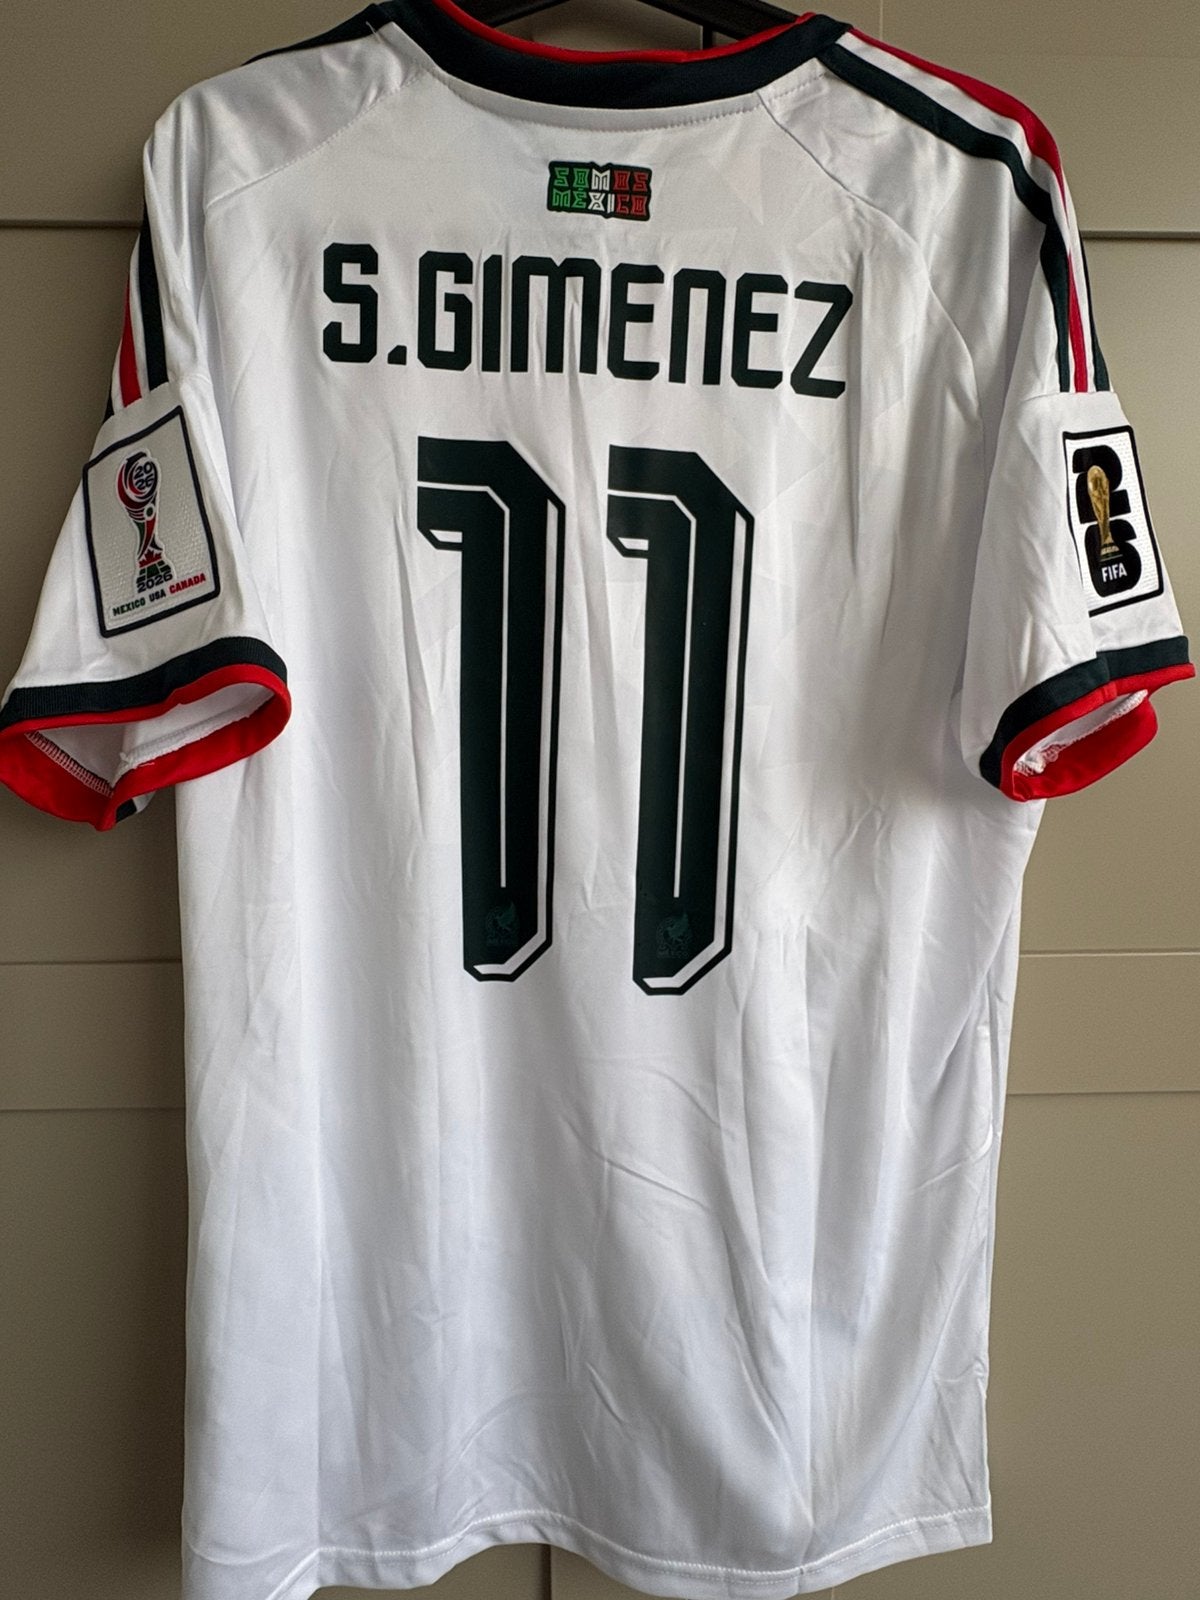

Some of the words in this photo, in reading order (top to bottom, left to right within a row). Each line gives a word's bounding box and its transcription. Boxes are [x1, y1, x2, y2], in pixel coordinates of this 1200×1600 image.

[553, 167, 649, 191] SOMOS
[323, 242, 853, 399] S.GIMENEZ
[136, 572, 173, 594] 2026
[1101, 562, 1127, 583] FIFA
[112, 597, 146, 617] MEXICO
[149, 589, 167, 602] USA
[169, 572, 206, 594] CANADA
[417, 436, 753, 995] 11
